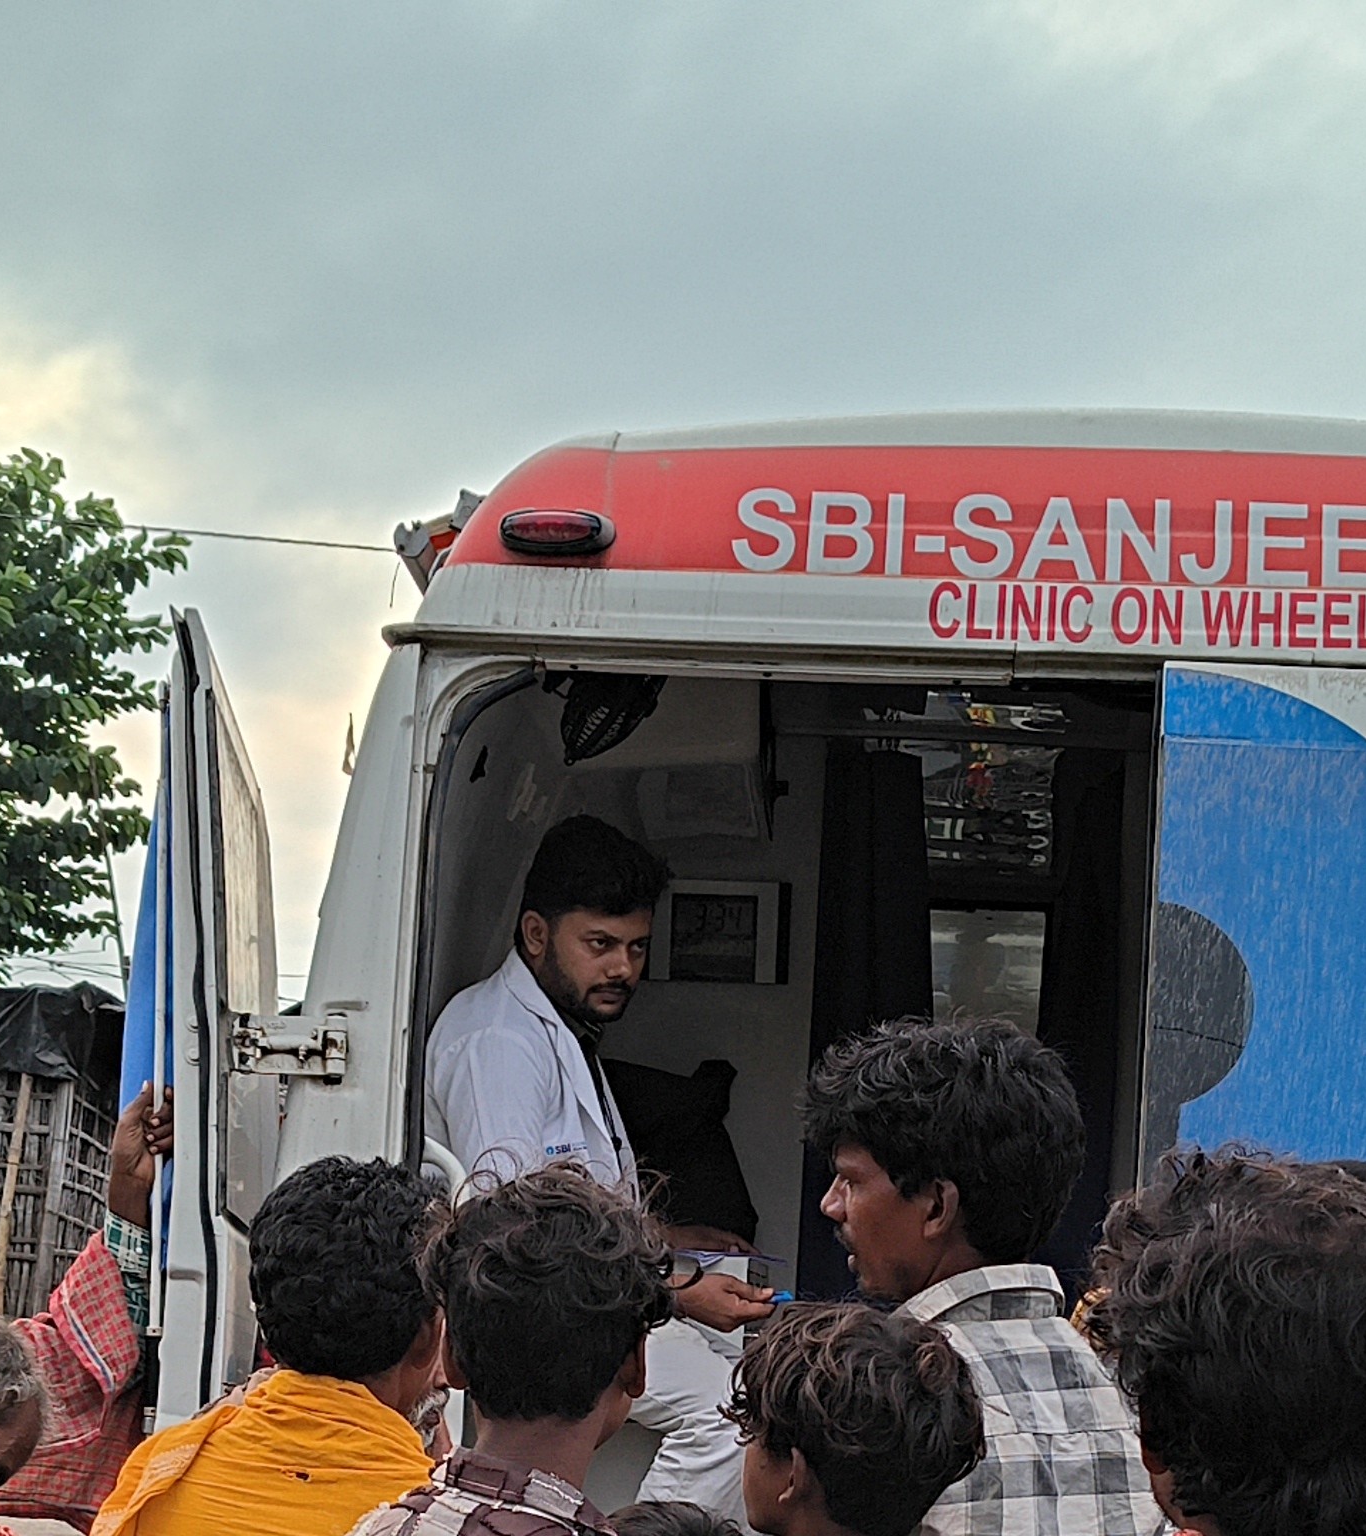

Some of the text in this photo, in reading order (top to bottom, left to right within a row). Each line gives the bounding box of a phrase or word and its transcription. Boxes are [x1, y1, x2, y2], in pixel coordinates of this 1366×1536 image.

[928, 581, 1094, 643] CLINIC
[1110, 587, 1184, 645] ON
[555, 1143, 571, 1155] SBI
